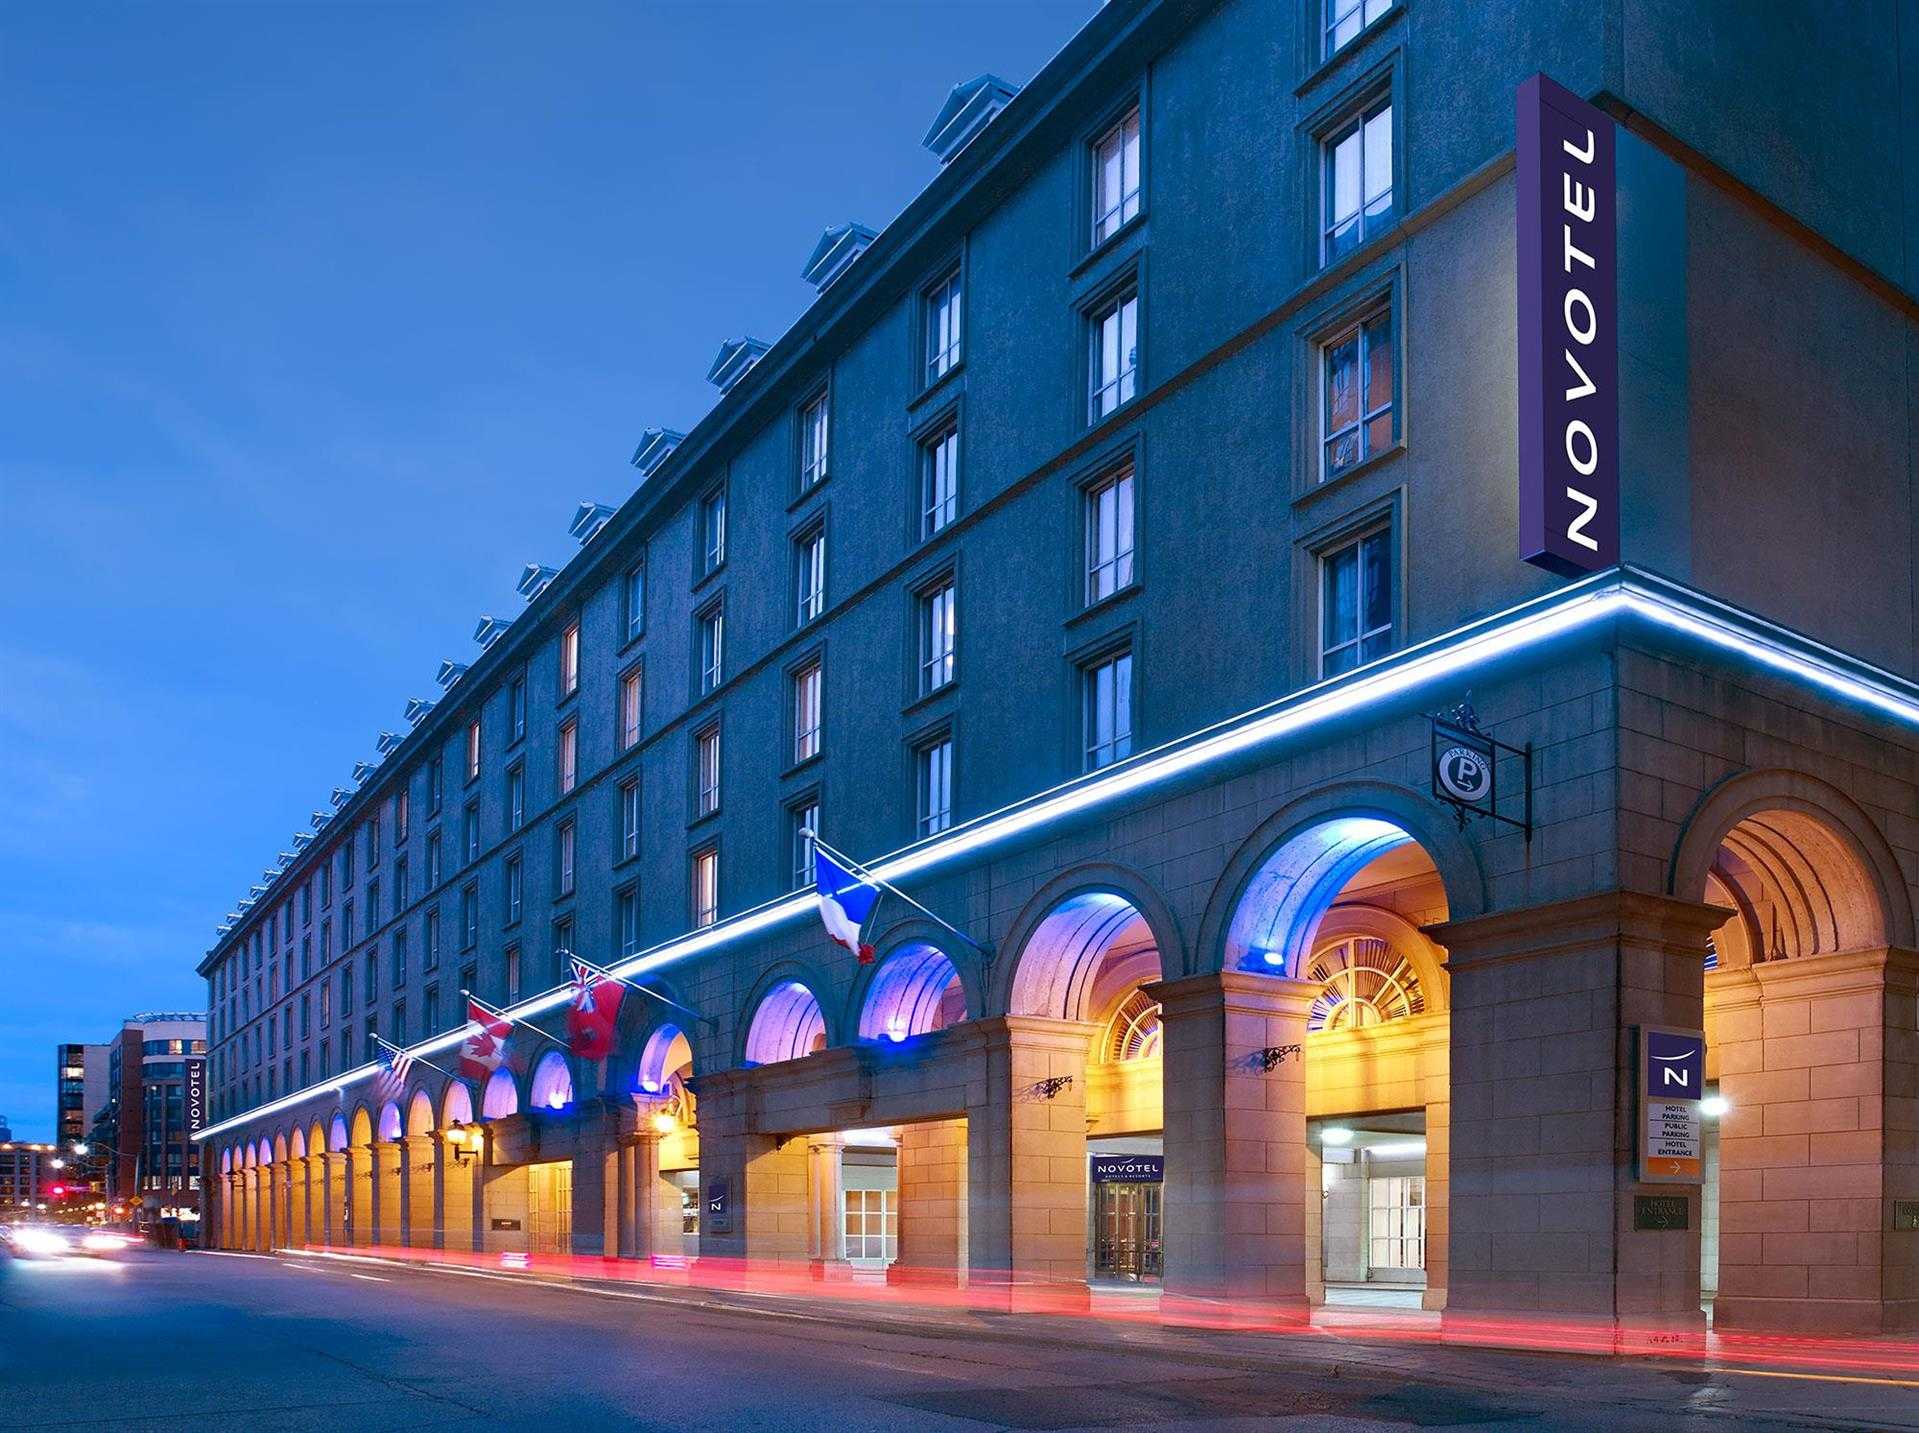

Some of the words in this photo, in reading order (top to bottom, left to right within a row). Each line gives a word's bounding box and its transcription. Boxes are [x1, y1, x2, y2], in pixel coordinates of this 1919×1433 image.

[1562, 128, 1600, 552] NOVOTEL
[1457, 757, 1477, 780] P
[1663, 1066, 1688, 1087] N
[191, 1062, 200, 1129] NOVOTEL
[1662, 1113, 1690, 1121] PARKING
[1664, 1122, 1688, 1130] PUBLIC
[1097, 1164, 1159, 1173] NOVOTEL
